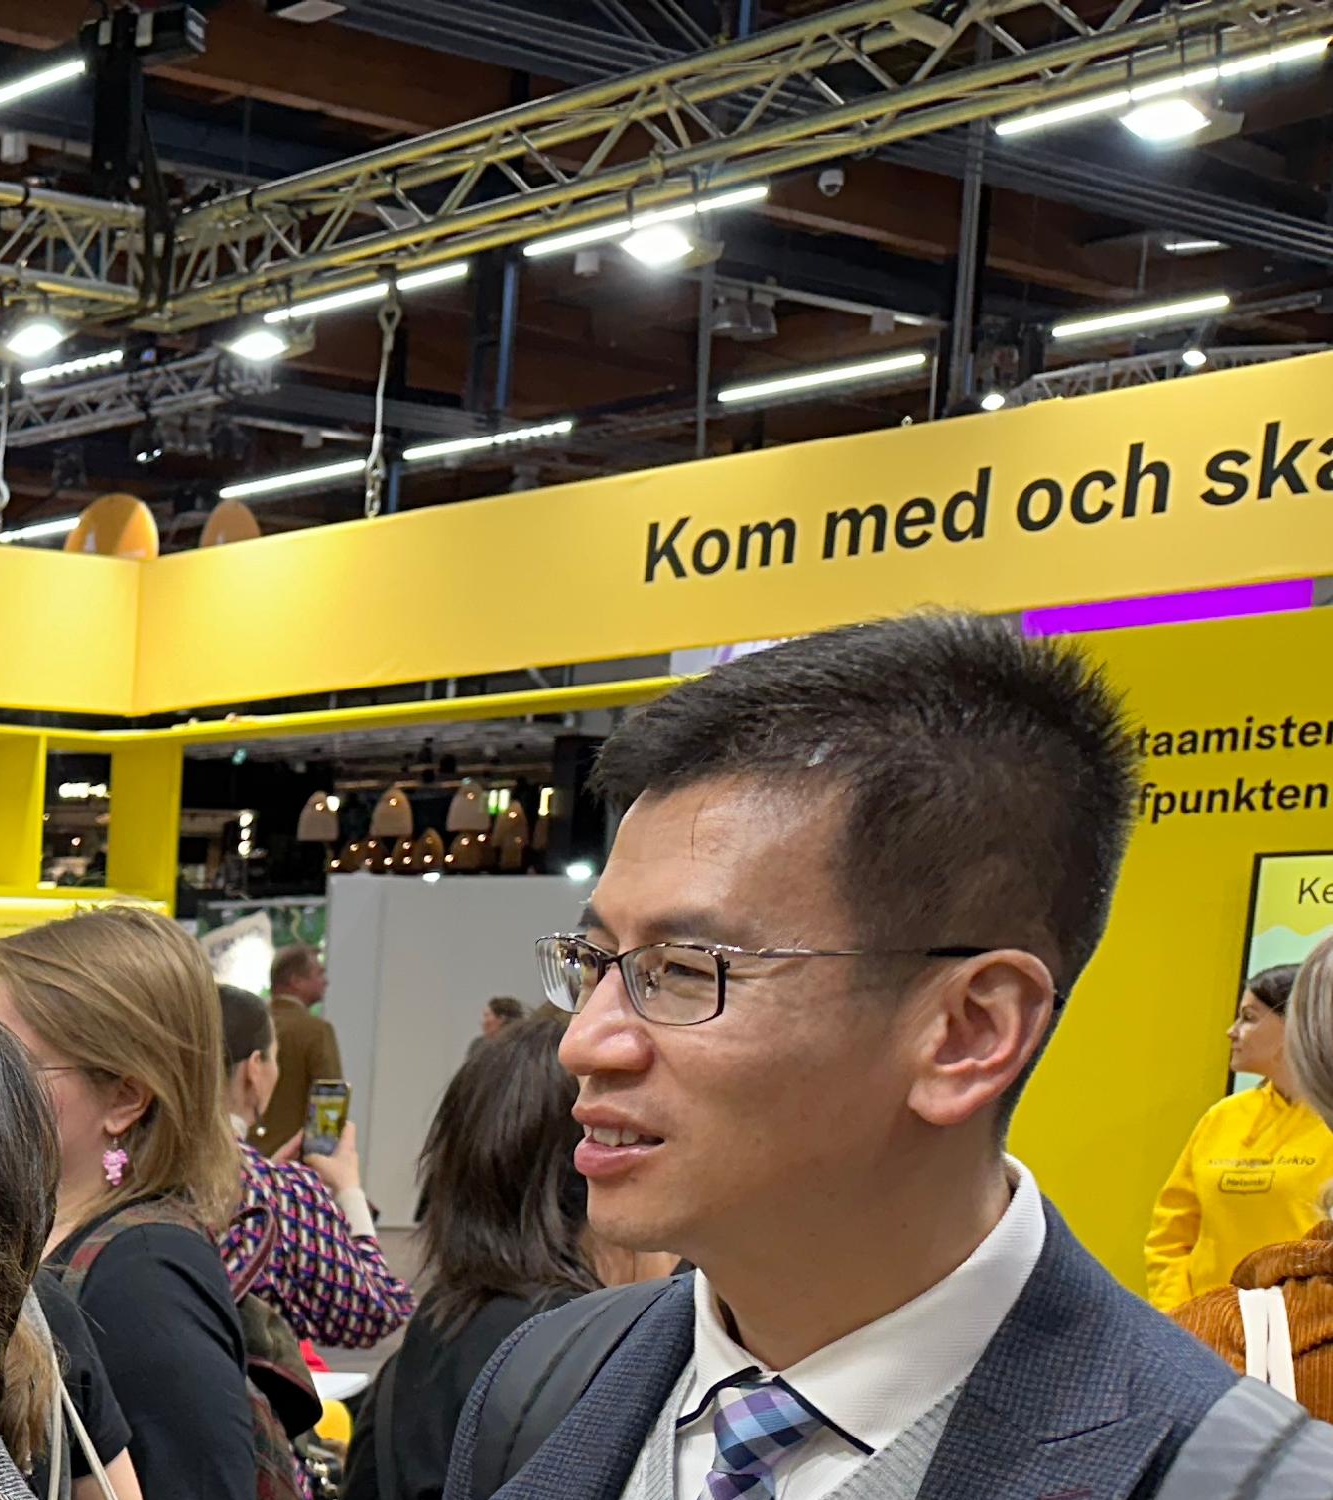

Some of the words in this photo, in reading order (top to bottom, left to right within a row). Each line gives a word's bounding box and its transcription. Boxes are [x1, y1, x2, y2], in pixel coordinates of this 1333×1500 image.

[644, 515, 797, 583] Kom
[822, 465, 993, 561] med
[1016, 441, 1172, 533] och
